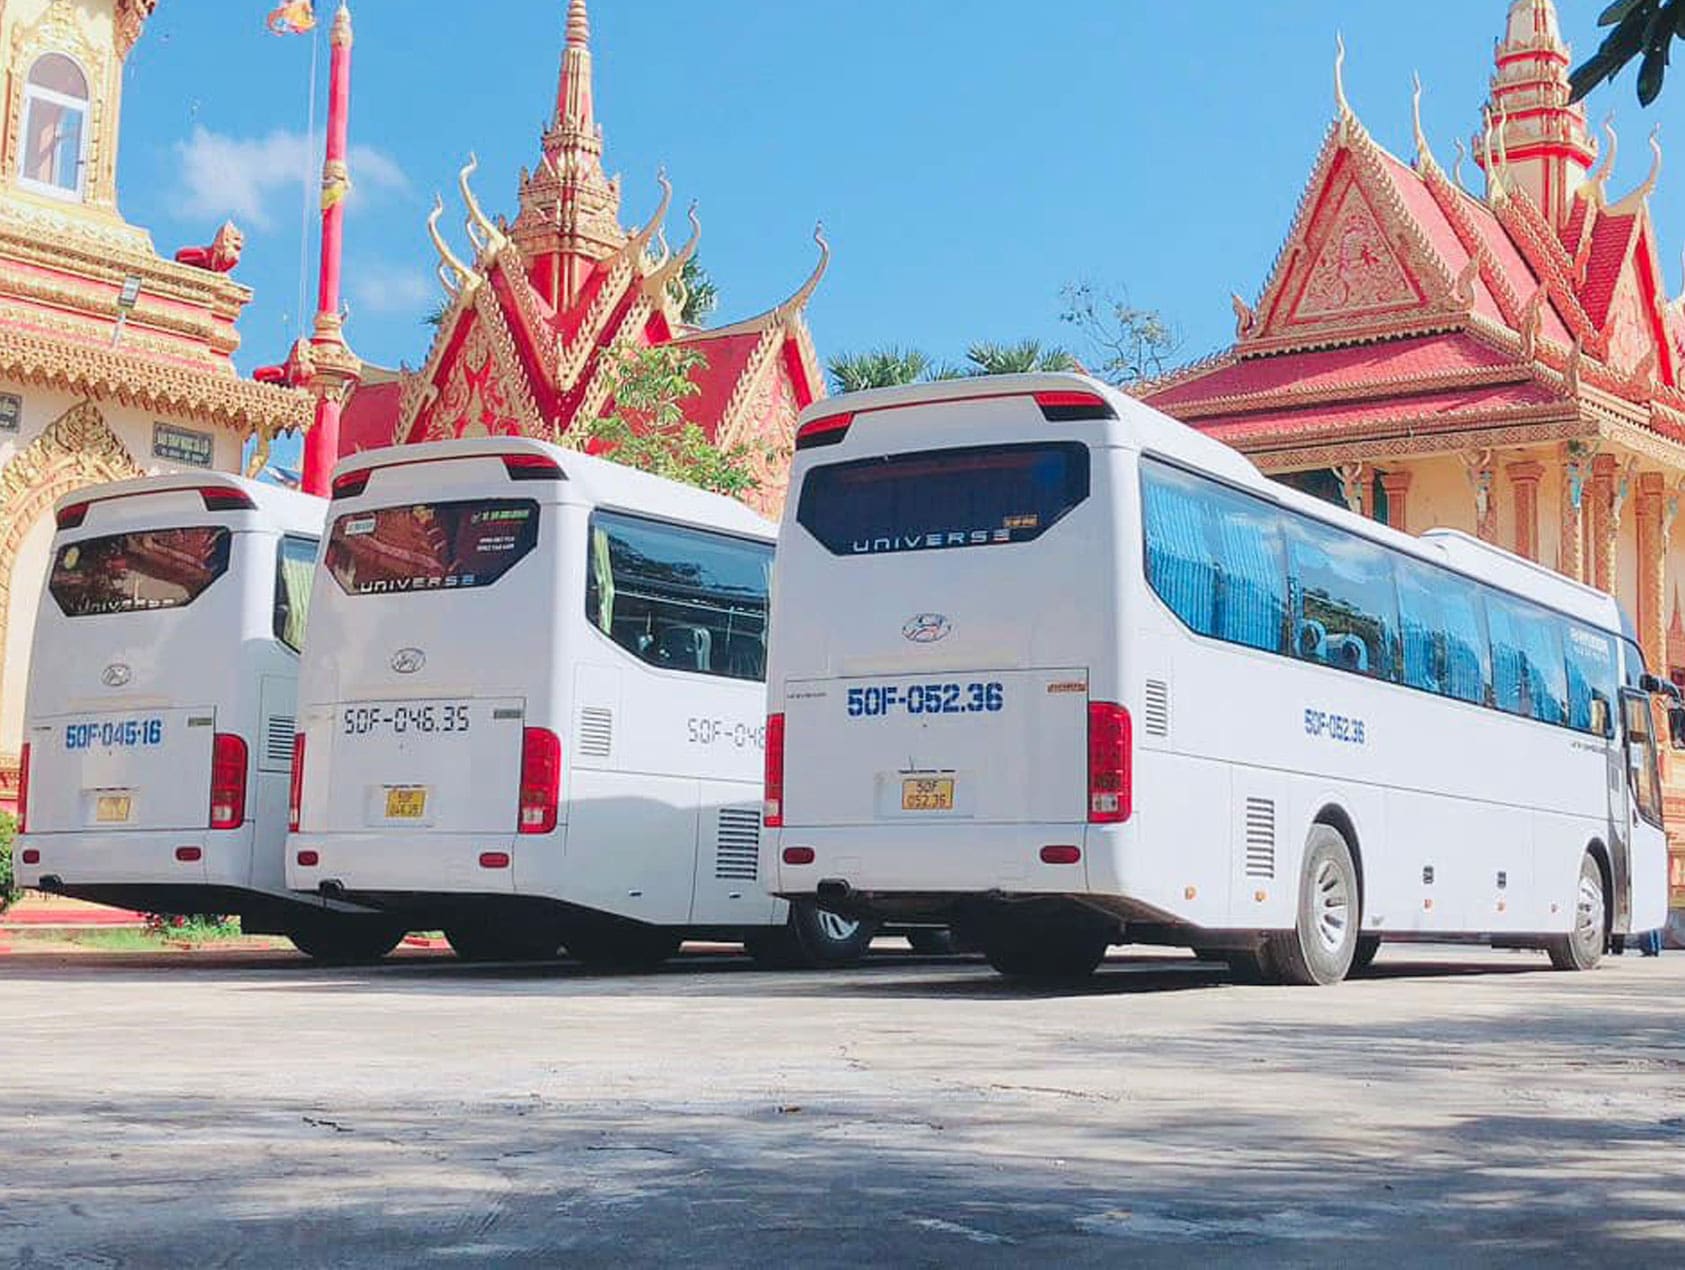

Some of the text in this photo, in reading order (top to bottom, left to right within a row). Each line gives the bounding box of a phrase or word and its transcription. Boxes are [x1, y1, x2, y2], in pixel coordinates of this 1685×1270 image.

[851, 529, 1010, 551] UNIVERSE
[360, 575, 475, 593] UNIVERSE
[848, 682, 1004, 716] 50F-052.36
[344, 706, 469, 734] 50F-046.35
